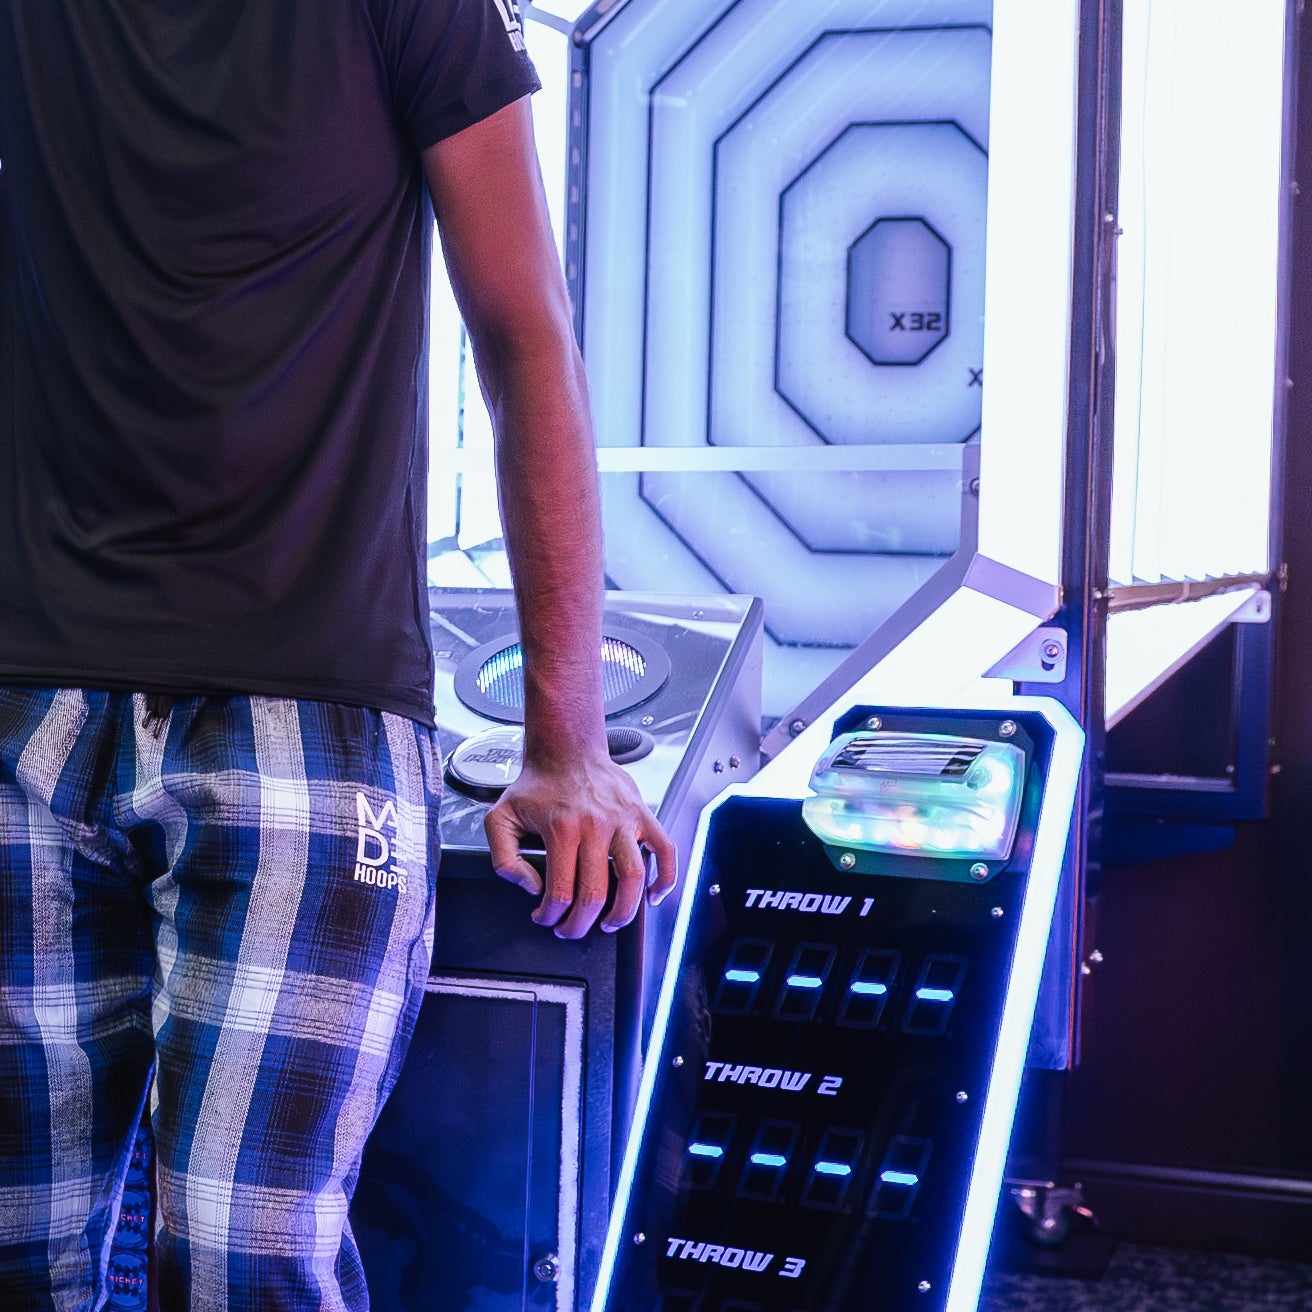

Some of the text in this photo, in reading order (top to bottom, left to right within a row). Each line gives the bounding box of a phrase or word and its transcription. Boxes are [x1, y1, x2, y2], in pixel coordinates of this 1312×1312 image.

[890, 311, 942, 331] X32
[354, 863, 408, 894] HOOPS
[744, 889, 875, 917] THROW 1
[704, 1061, 843, 1096] THROW 2
[666, 1237, 806, 1278] THROW 3
